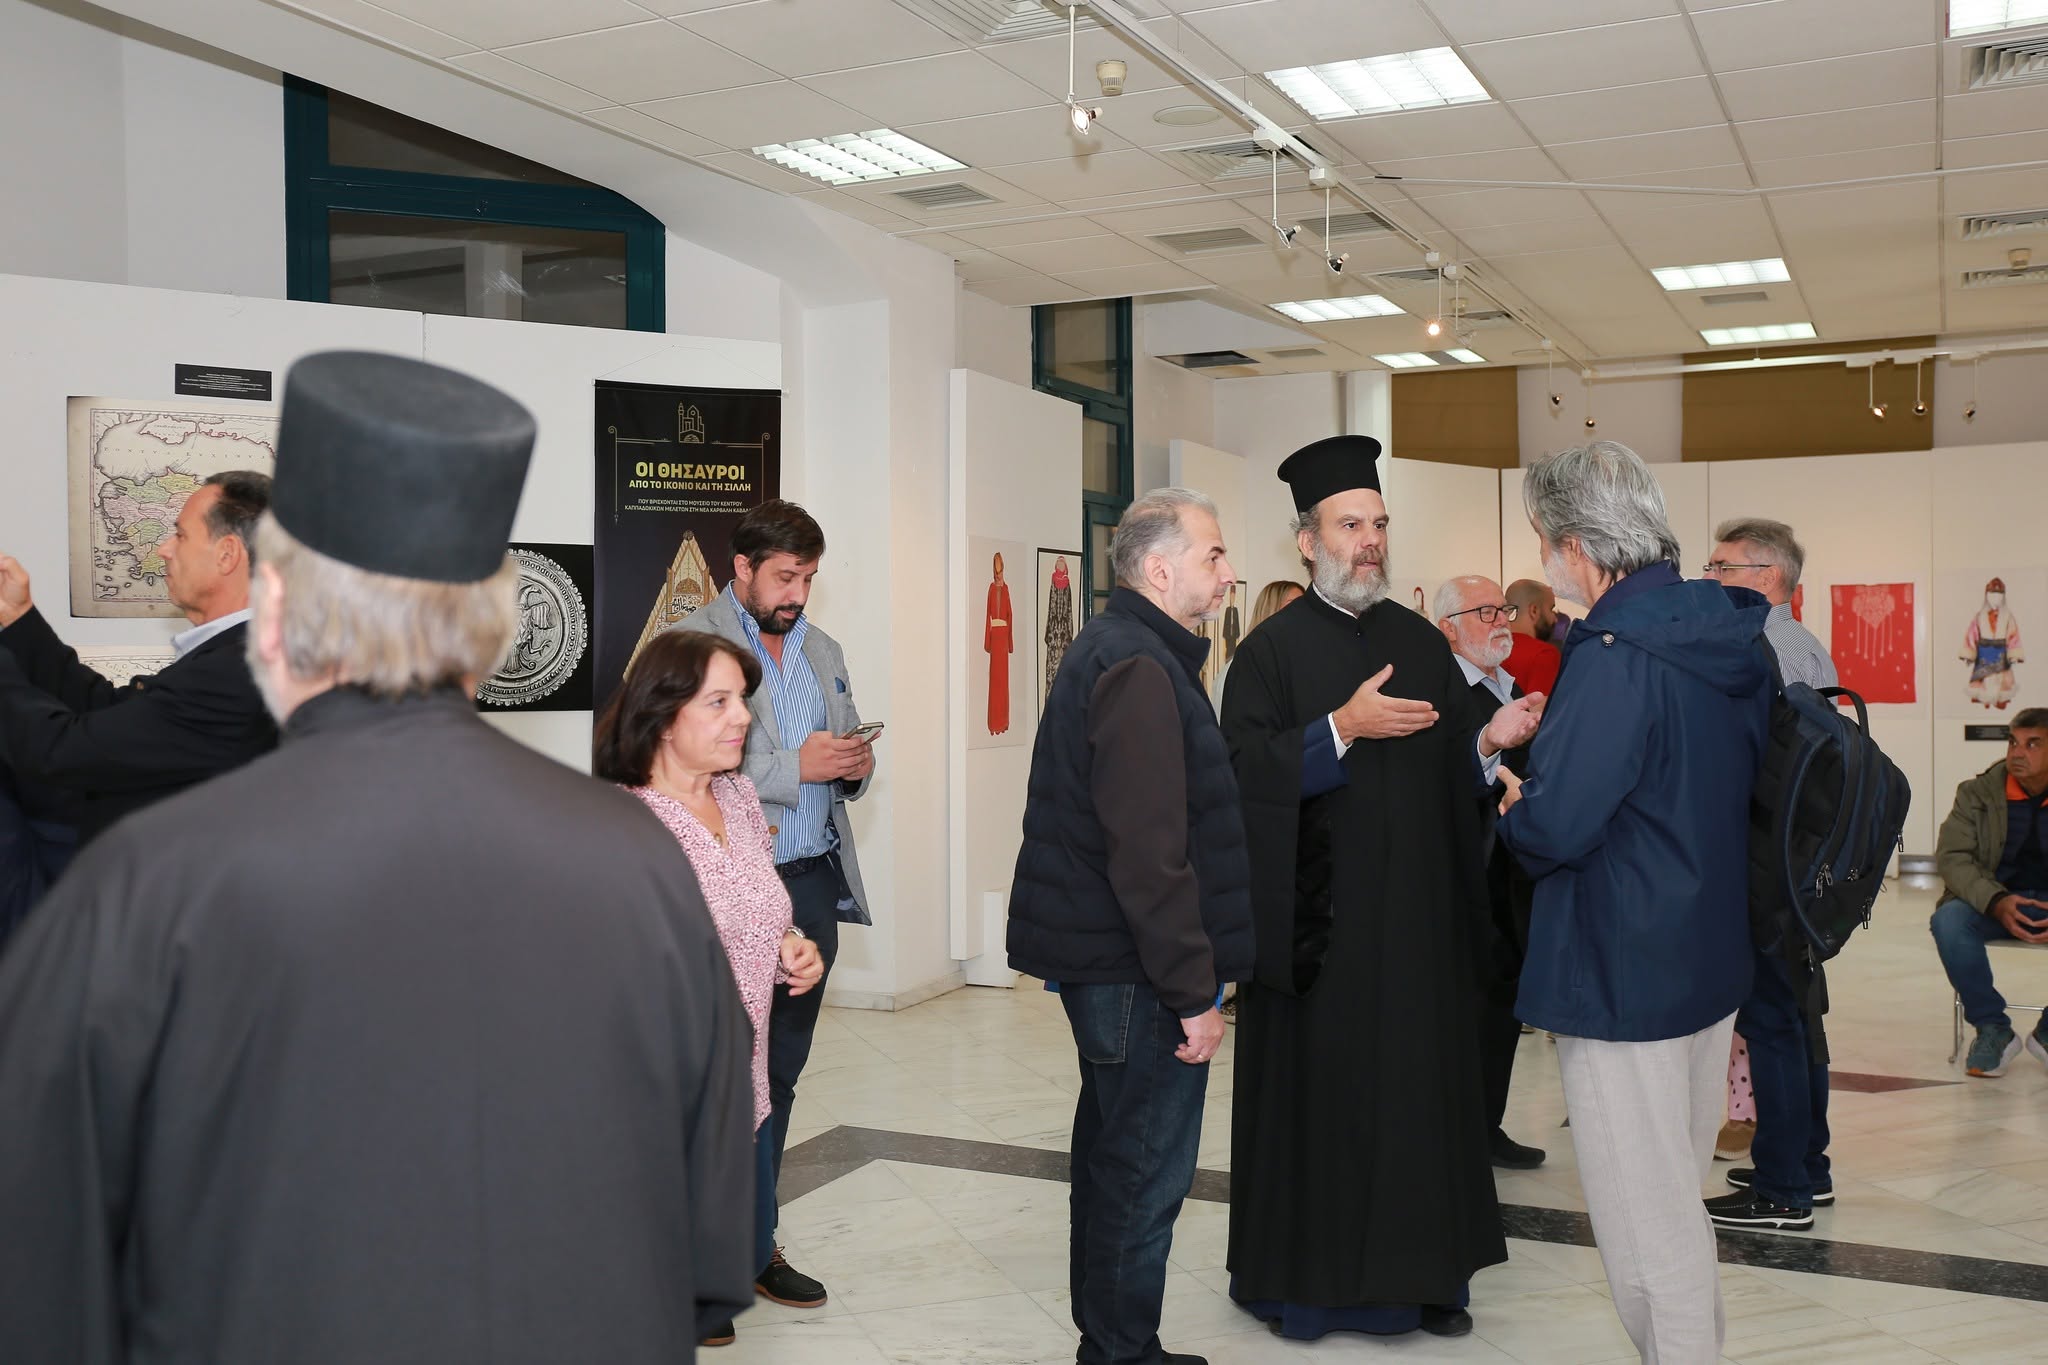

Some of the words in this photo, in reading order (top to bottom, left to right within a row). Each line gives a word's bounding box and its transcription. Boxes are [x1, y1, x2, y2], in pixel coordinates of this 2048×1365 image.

[635, 461, 654, 477] ΟΙ
[657, 462, 745, 480] ΘΗΣΑΥΡΟΙ
[629, 480, 649, 489] ΑΠΟ
[650, 480, 662, 489] ΤΟ
[663, 481, 694, 490] ΙΚΟΝΙΟ
[695, 482, 710, 491] ΚΑΙ
[711, 482, 723, 491] ΤΗ
[724, 483, 751, 491] ΣΙΛΛΗ
